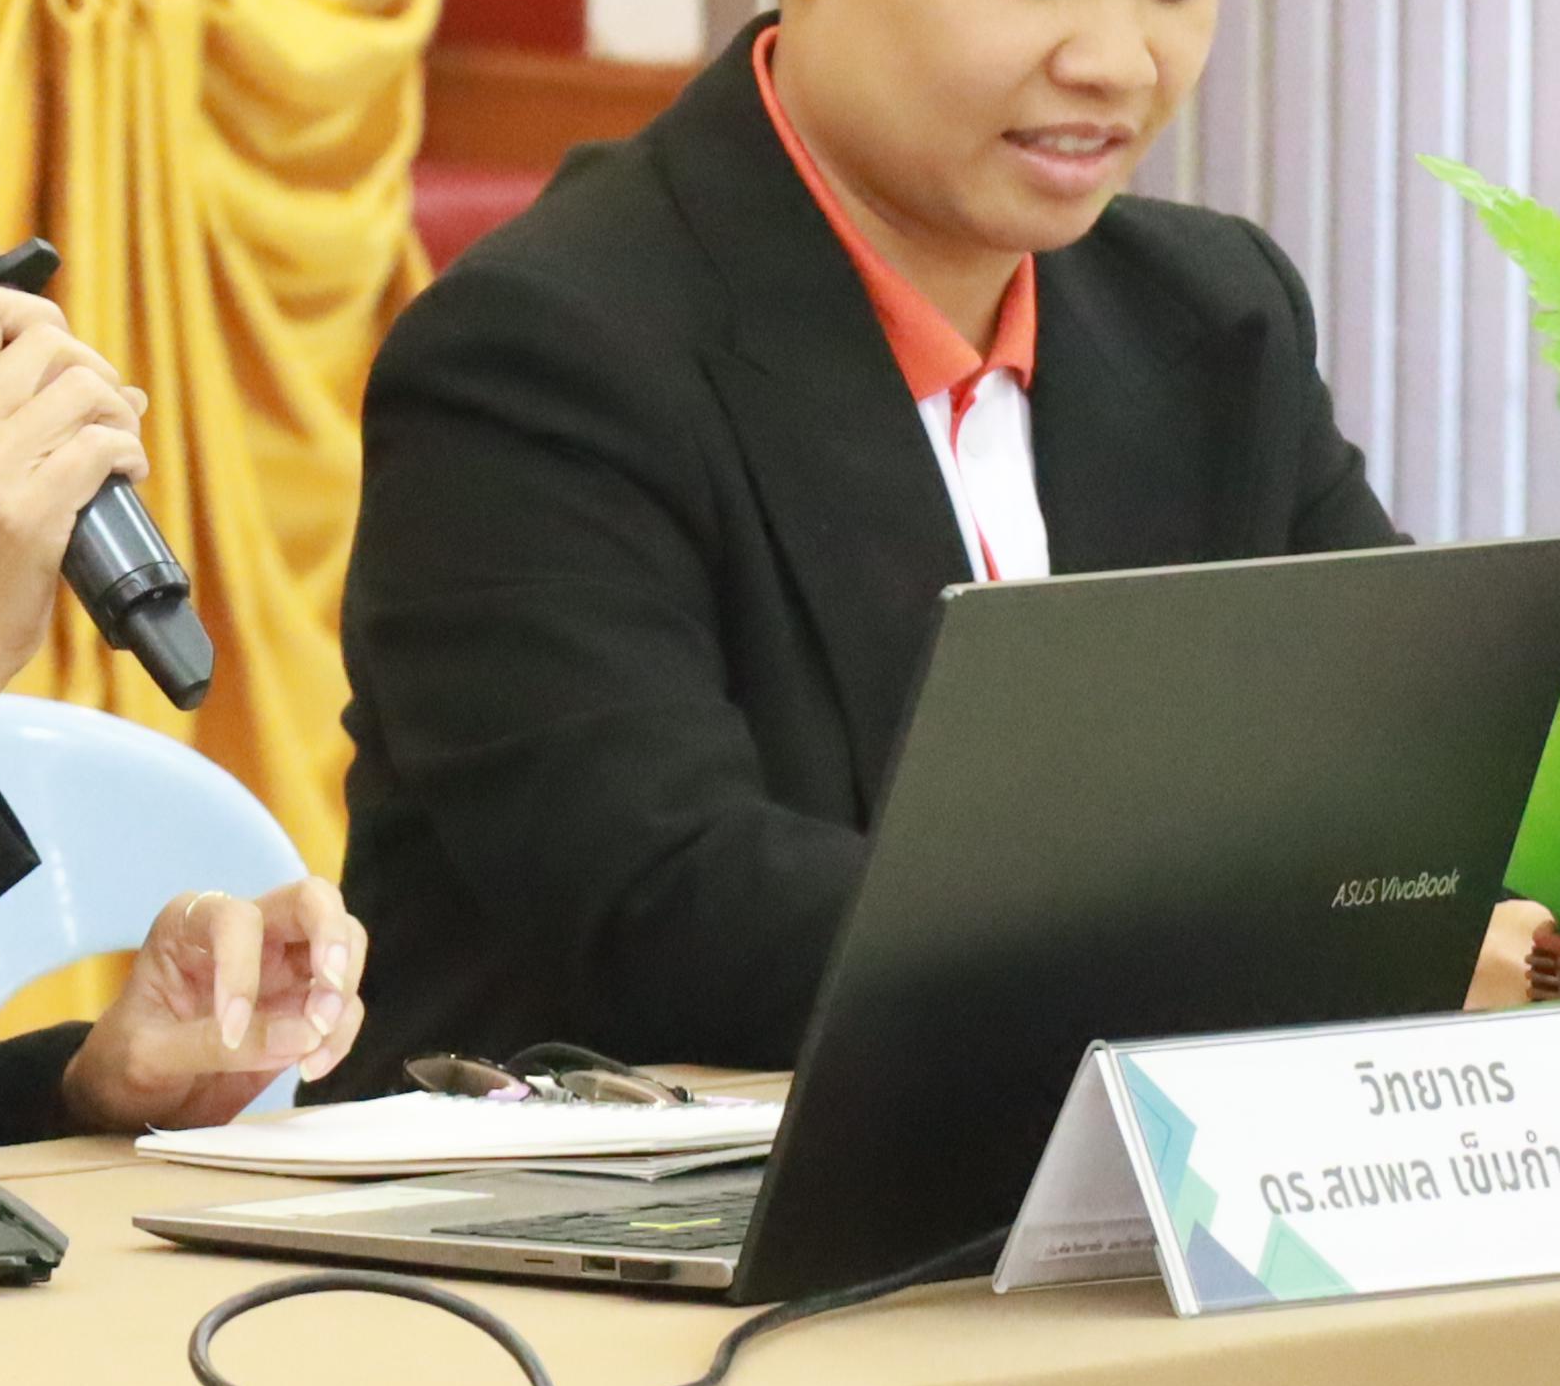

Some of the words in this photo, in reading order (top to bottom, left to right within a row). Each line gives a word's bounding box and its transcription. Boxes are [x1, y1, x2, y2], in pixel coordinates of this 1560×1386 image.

[1331, 878, 1379, 909] ASUS
[1380, 868, 1461, 903] VivoBook
[1354, 1060, 1516, 1117] วิทยากร
[1259, 1157, 1442, 1216] ดร.สมพล
